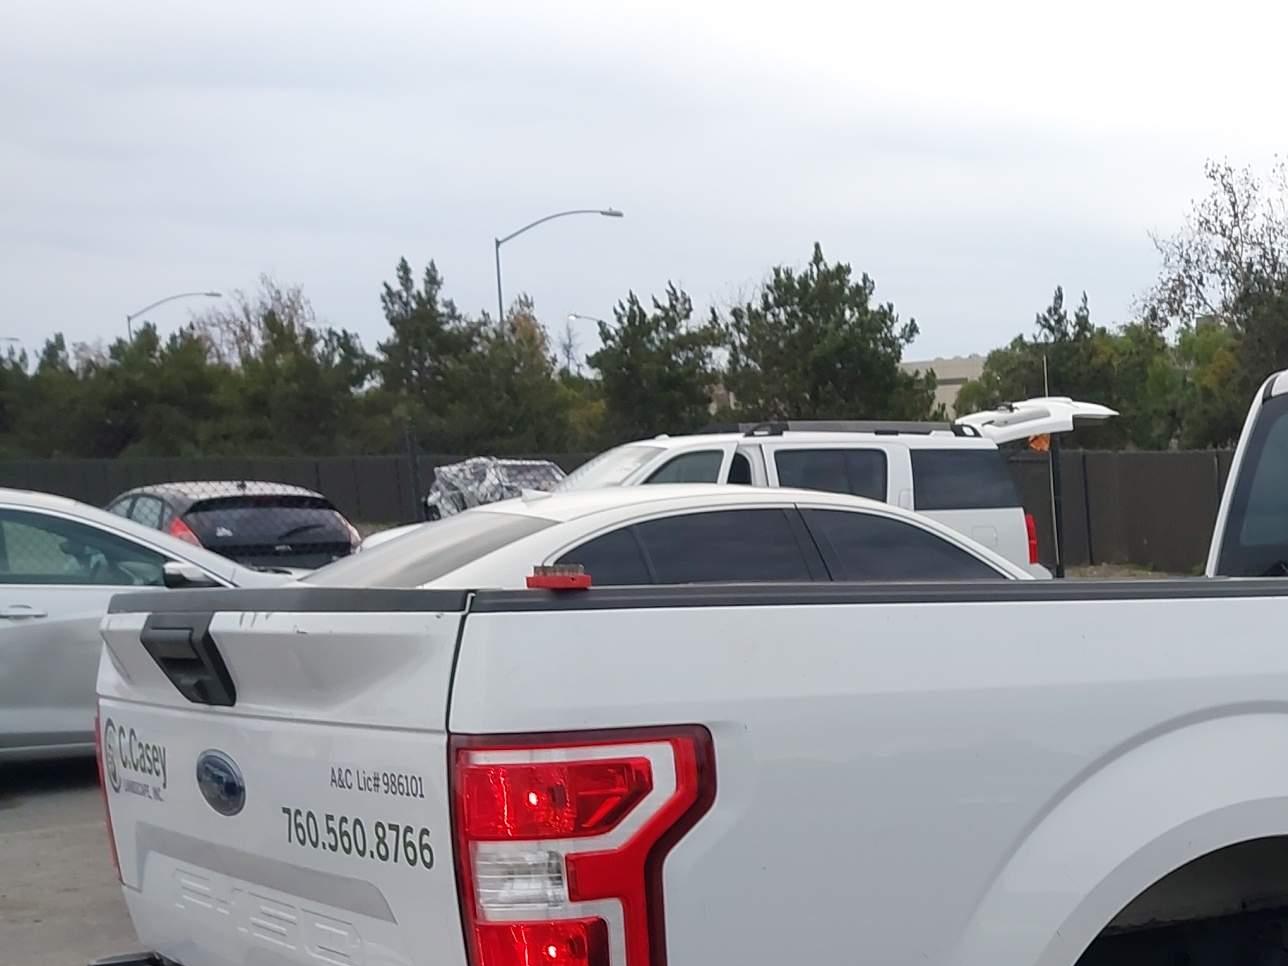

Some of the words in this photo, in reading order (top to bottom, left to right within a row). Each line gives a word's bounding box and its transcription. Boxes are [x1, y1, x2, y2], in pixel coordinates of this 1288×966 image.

[119, 725, 167, 789] C.Casey
[330, 767, 353, 790] A&C
[282, 807, 434, 869] 760.560.8766
